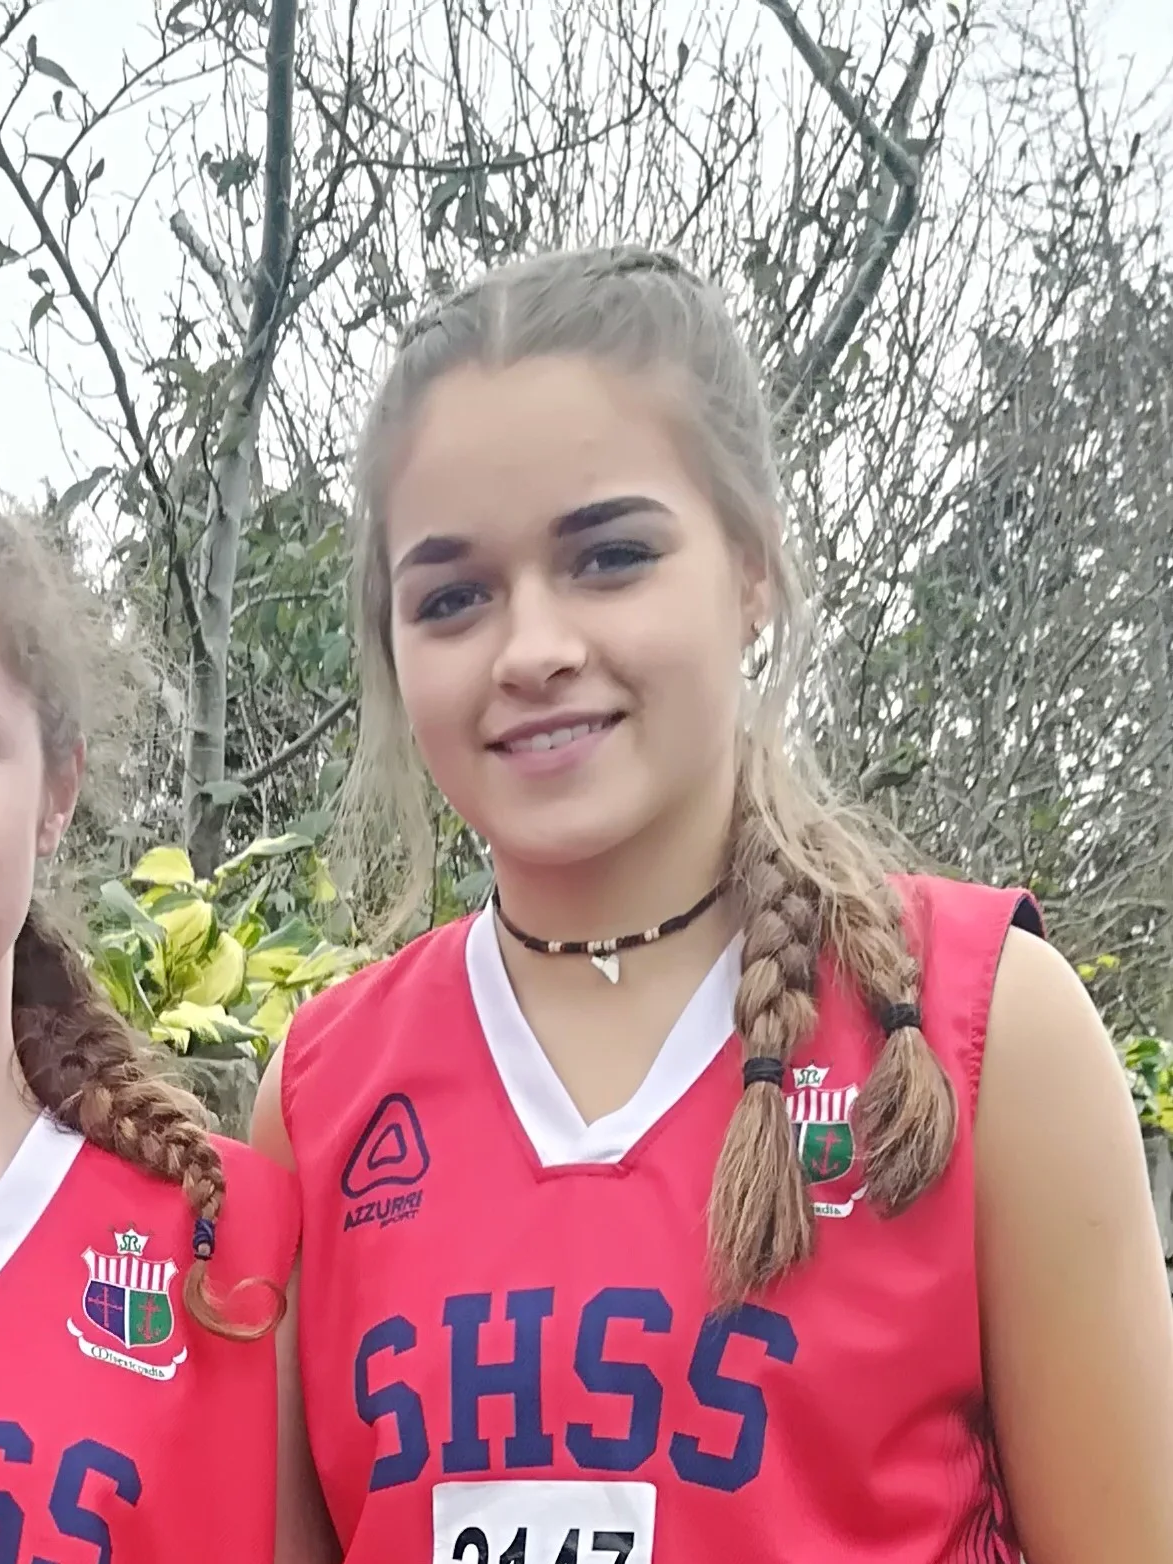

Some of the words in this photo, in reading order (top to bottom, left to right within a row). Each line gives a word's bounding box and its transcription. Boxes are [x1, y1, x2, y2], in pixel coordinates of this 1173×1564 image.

[343, 1189, 423, 1233] AZZURRI
[379, 1210, 420, 1230] SPORT
[355, 1286, 799, 1493] SHSS
